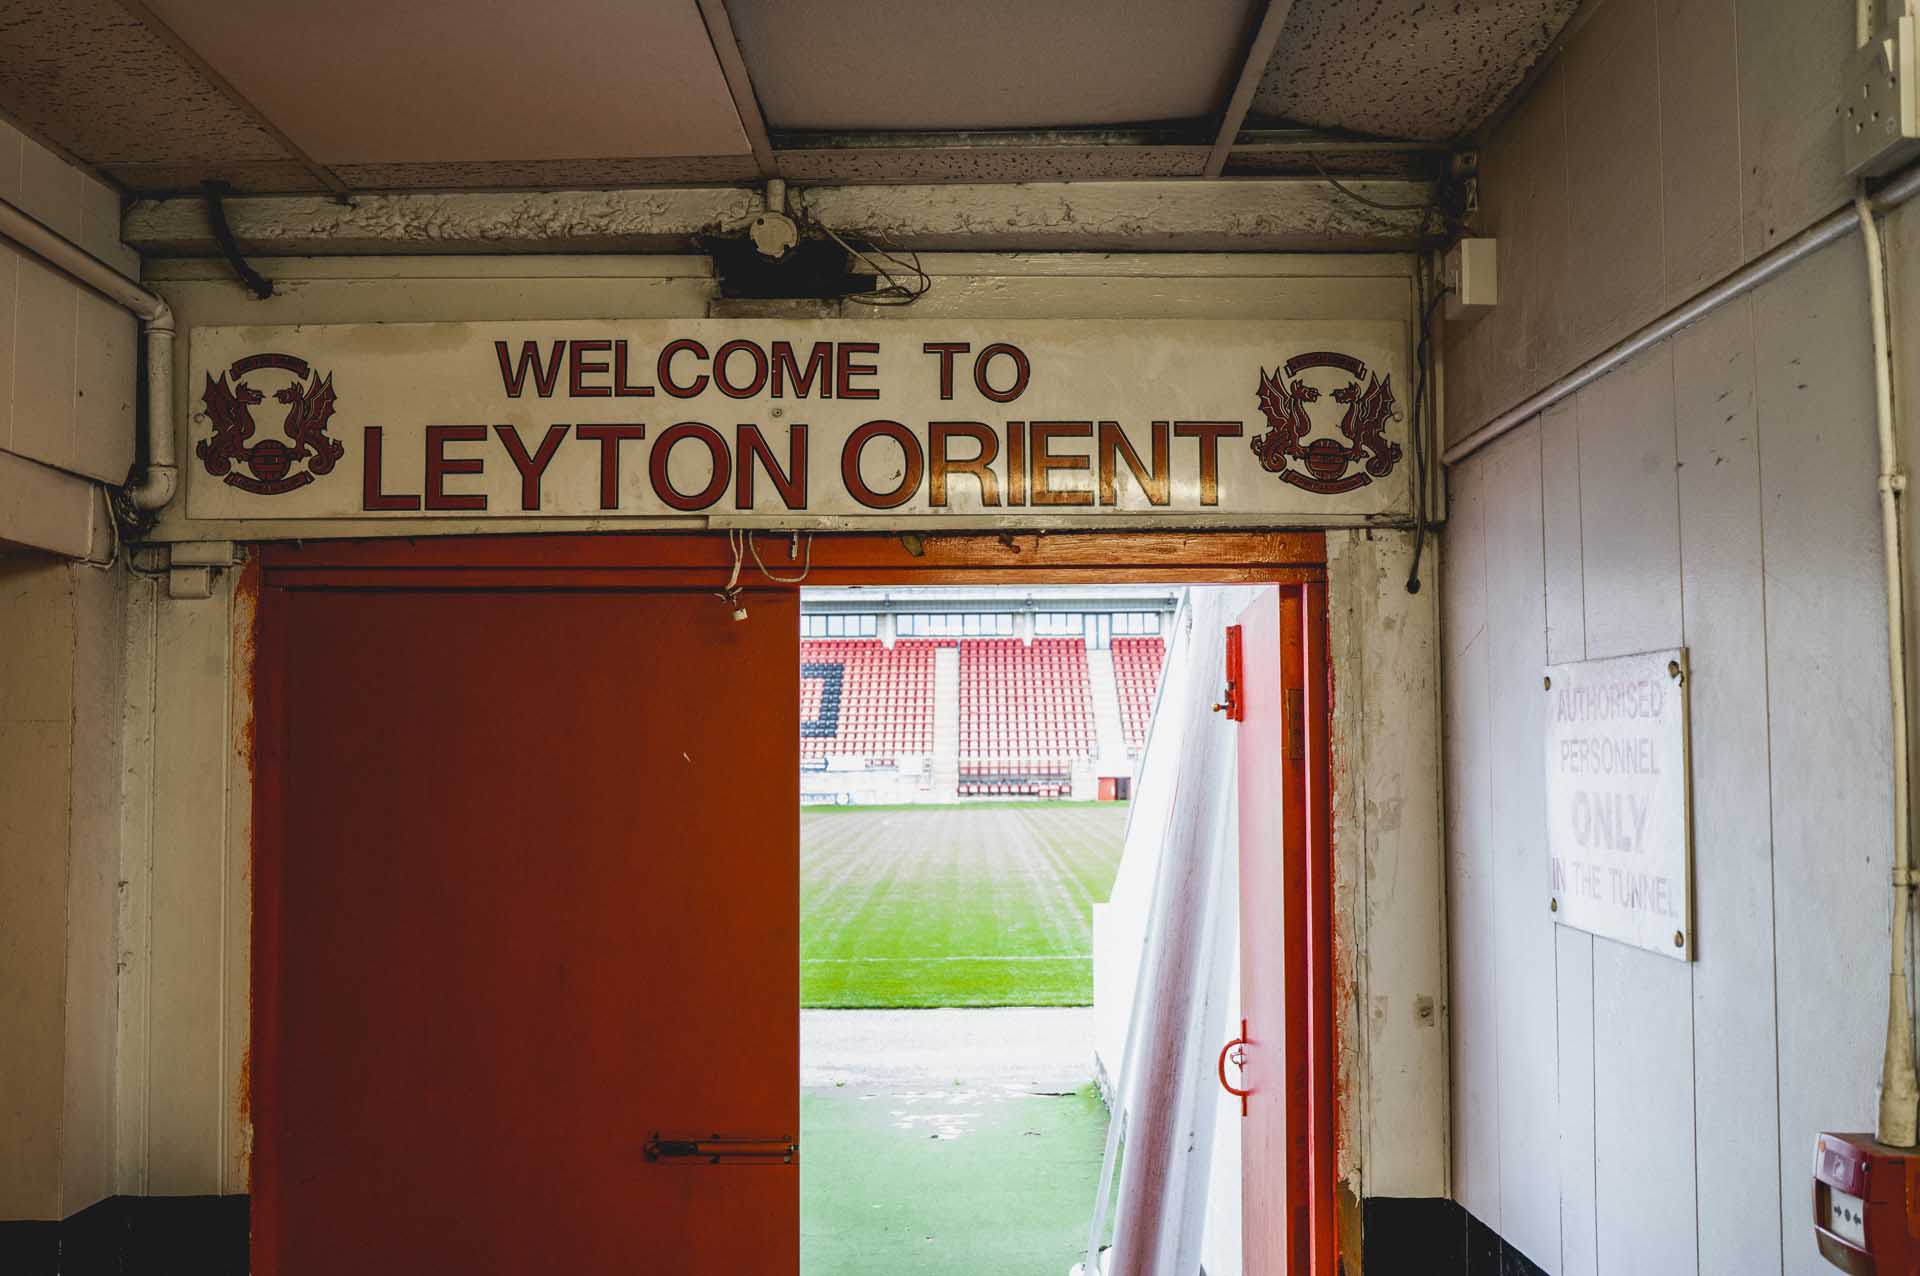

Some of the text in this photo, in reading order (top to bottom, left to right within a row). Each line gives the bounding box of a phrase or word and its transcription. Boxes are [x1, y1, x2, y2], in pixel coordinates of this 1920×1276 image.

[494, 338, 1030, 403] WELCOME TO
[362, 420, 1243, 511] LEYTON ORIENT
[1556, 680, 1664, 723] AUTHORISED
[1560, 738, 1660, 775] PERSONNEL
[1570, 791, 1649, 853] ONLY
[1552, 857, 1678, 919] IN THE TUNNEL
